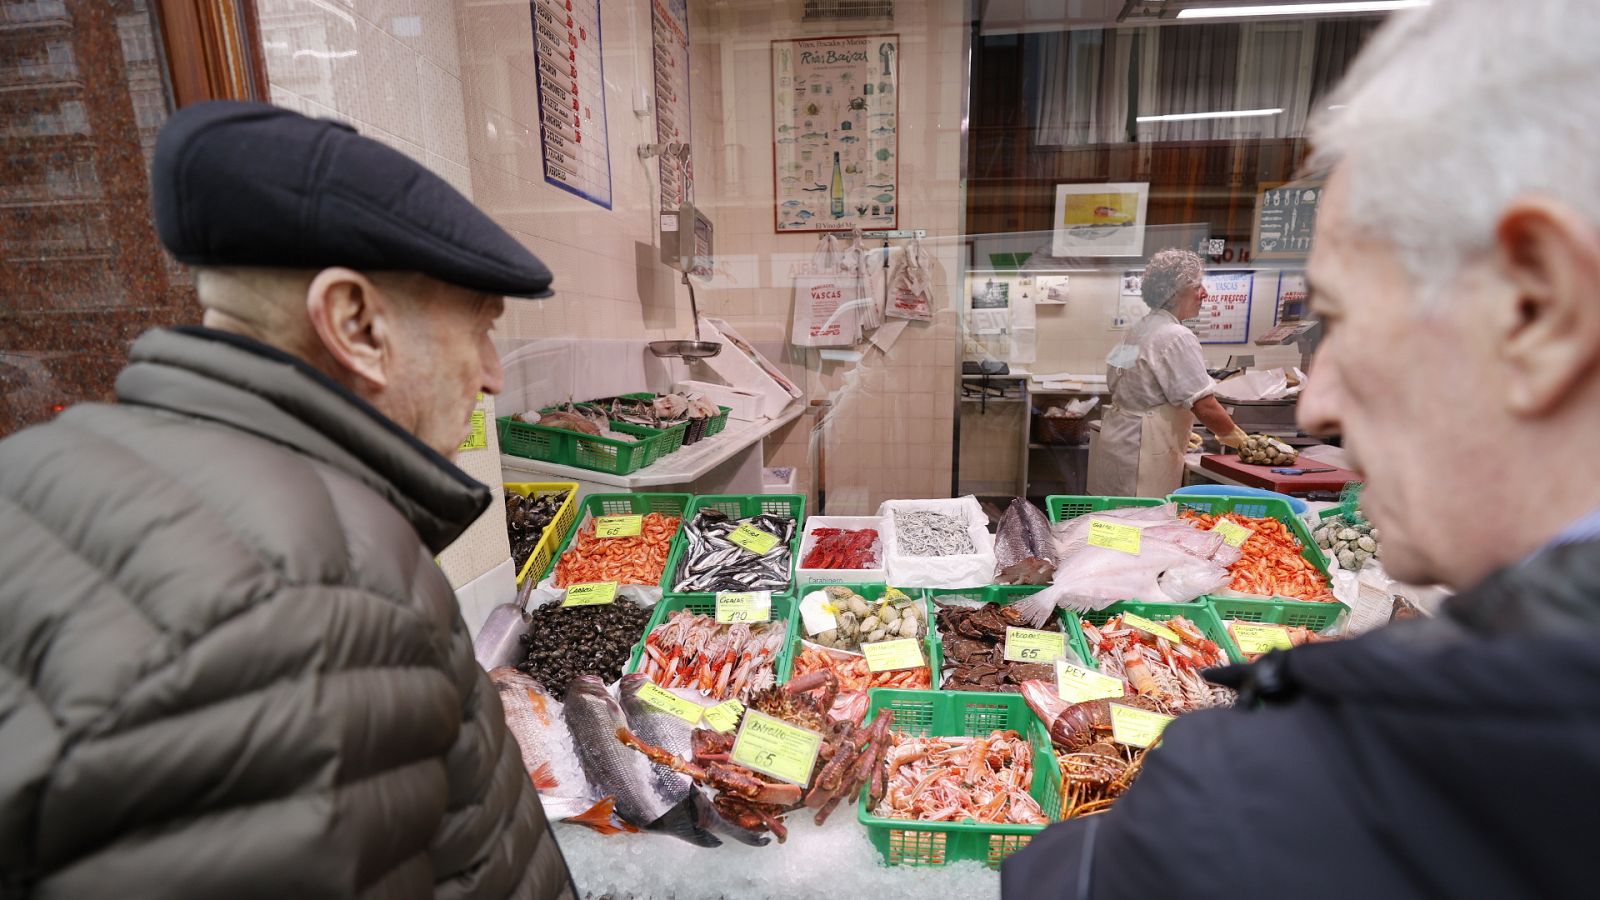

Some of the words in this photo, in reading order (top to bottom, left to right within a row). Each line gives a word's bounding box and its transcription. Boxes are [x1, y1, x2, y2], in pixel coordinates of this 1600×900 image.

[811, 291, 841, 300] VASCAS
[1220, 293, 1248, 303] FRESCOS
[1021, 648, 1041, 659] 65
[755, 750, 777, 768] 65
